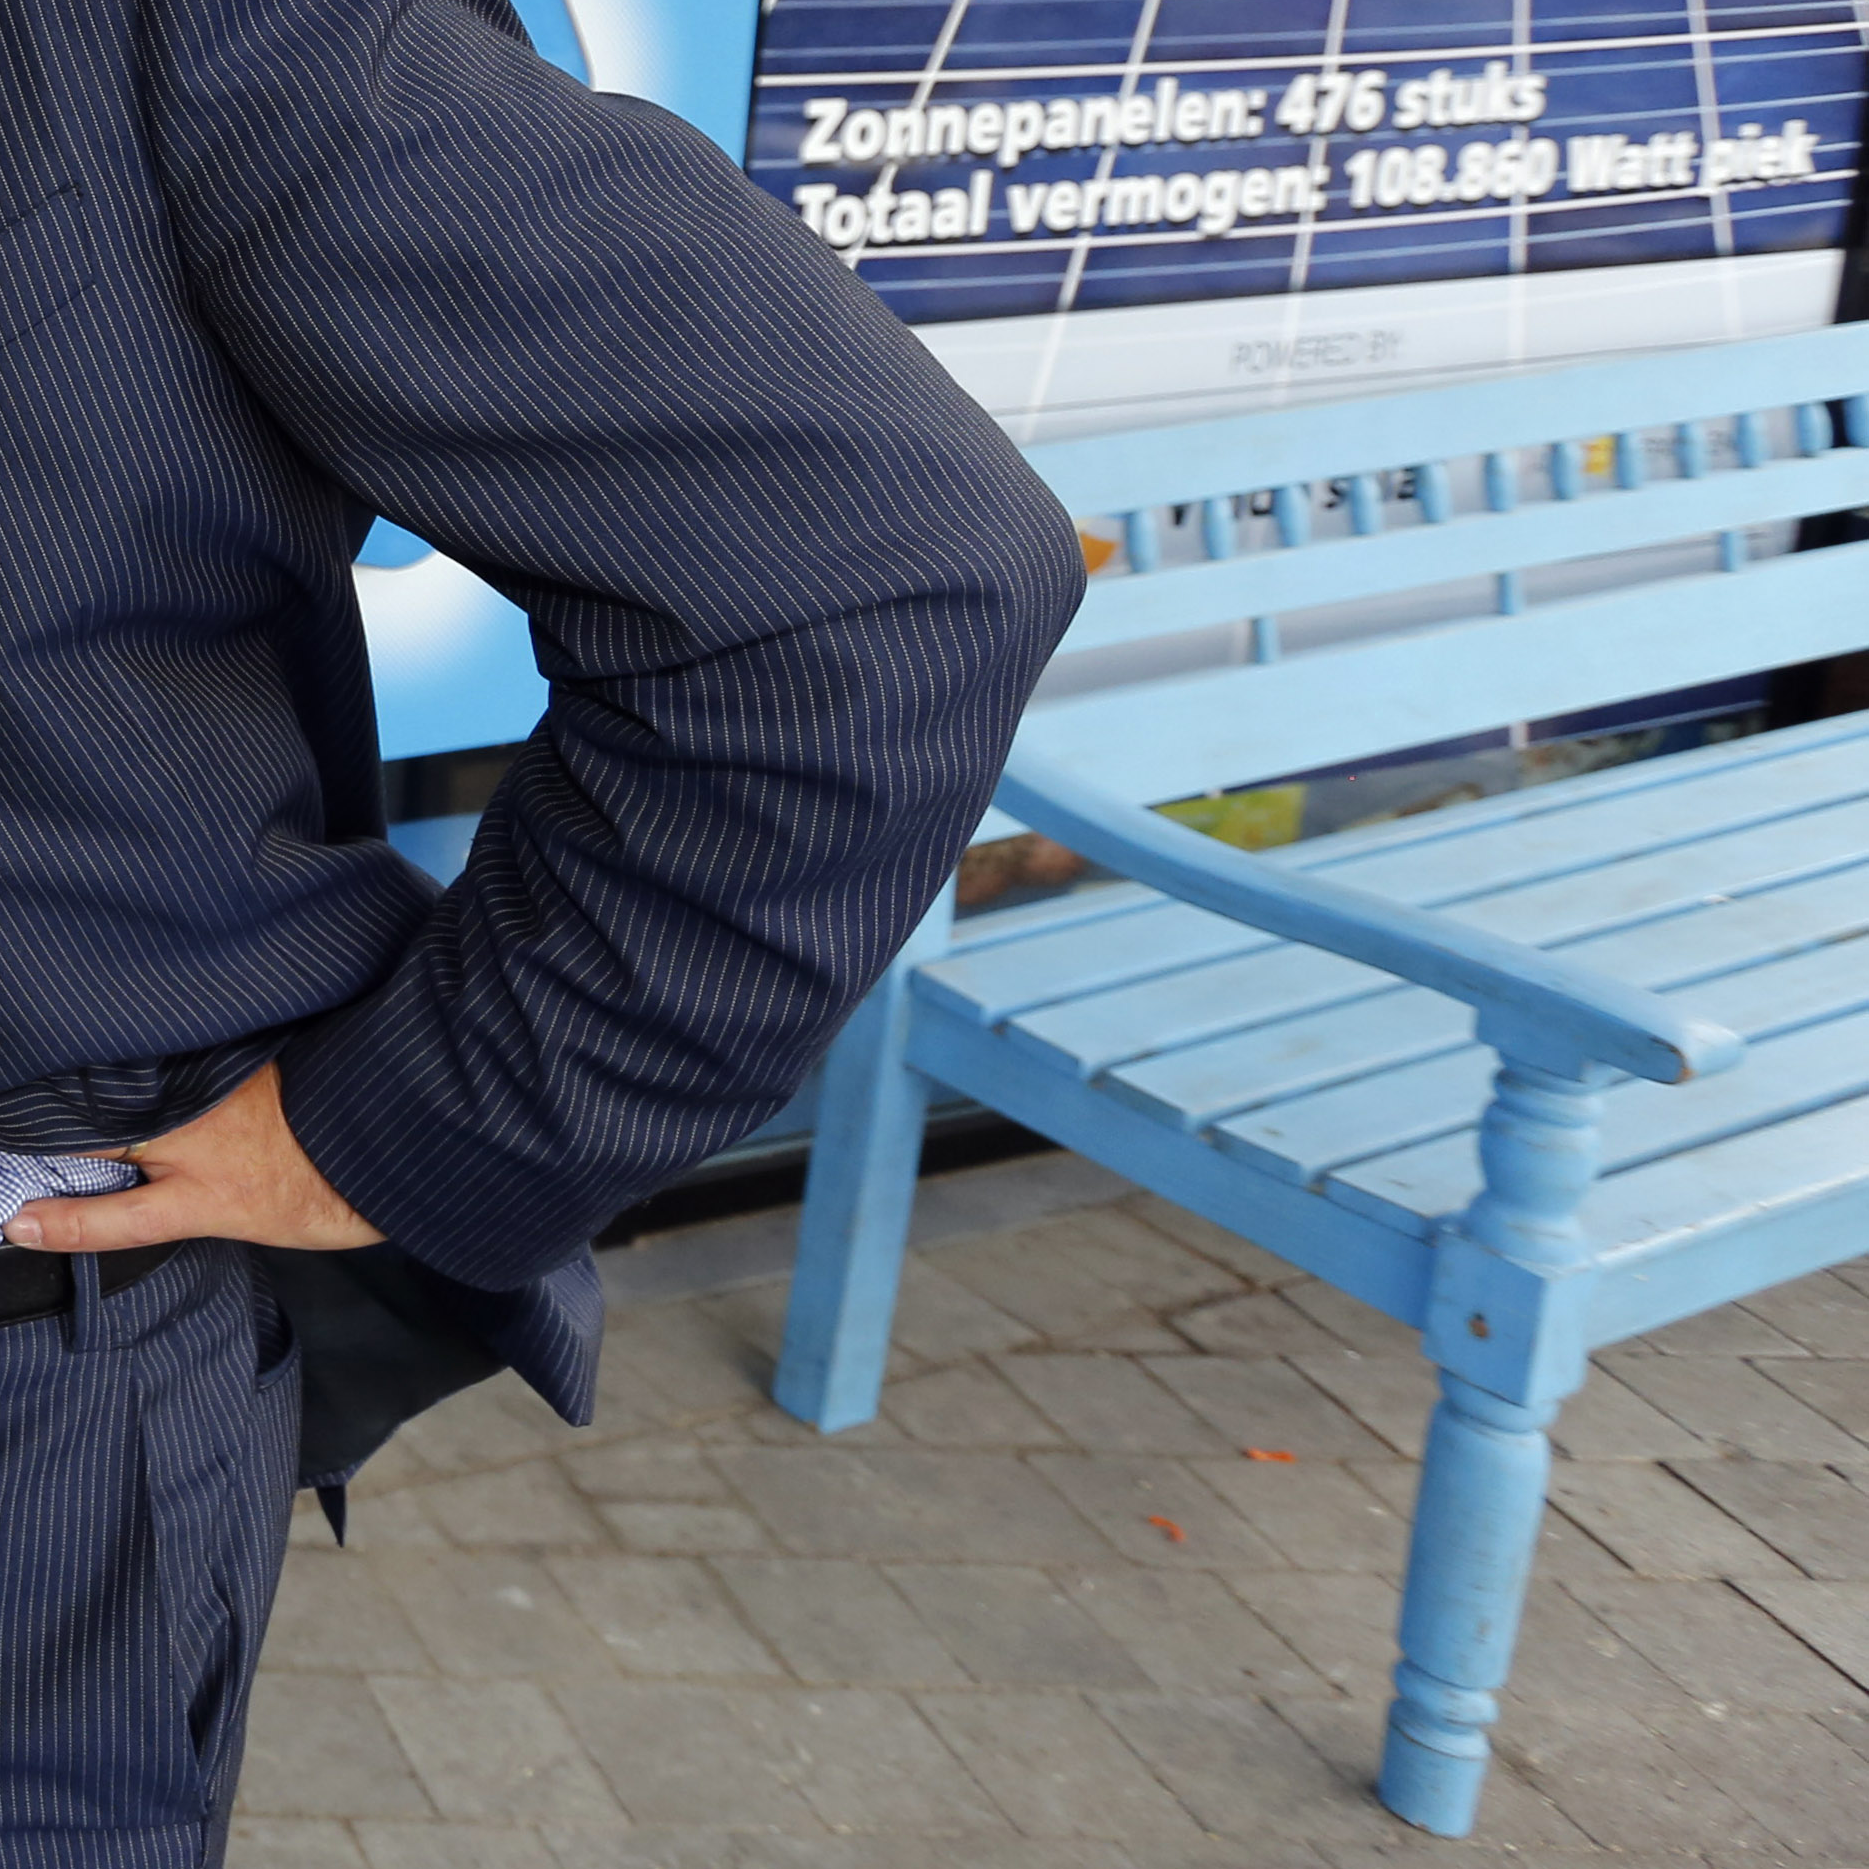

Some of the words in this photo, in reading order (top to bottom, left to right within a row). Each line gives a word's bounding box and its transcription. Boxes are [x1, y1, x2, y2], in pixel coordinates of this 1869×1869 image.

[801, 77, 1264, 167] Zonnepanelen:
[1275, 69, 1387, 133] 476
[1392, 60, 1547, 128] stuks
[794, 169, 993, 247] Totaal
[1007, 165, 1330, 234] vermogen:
[1567, 131, 1701, 193] Watt
[1702, 120, 1820, 194] piek
[1229, 332, 1363, 374] POWERED
[1366, 330, 1404, 362] BY
